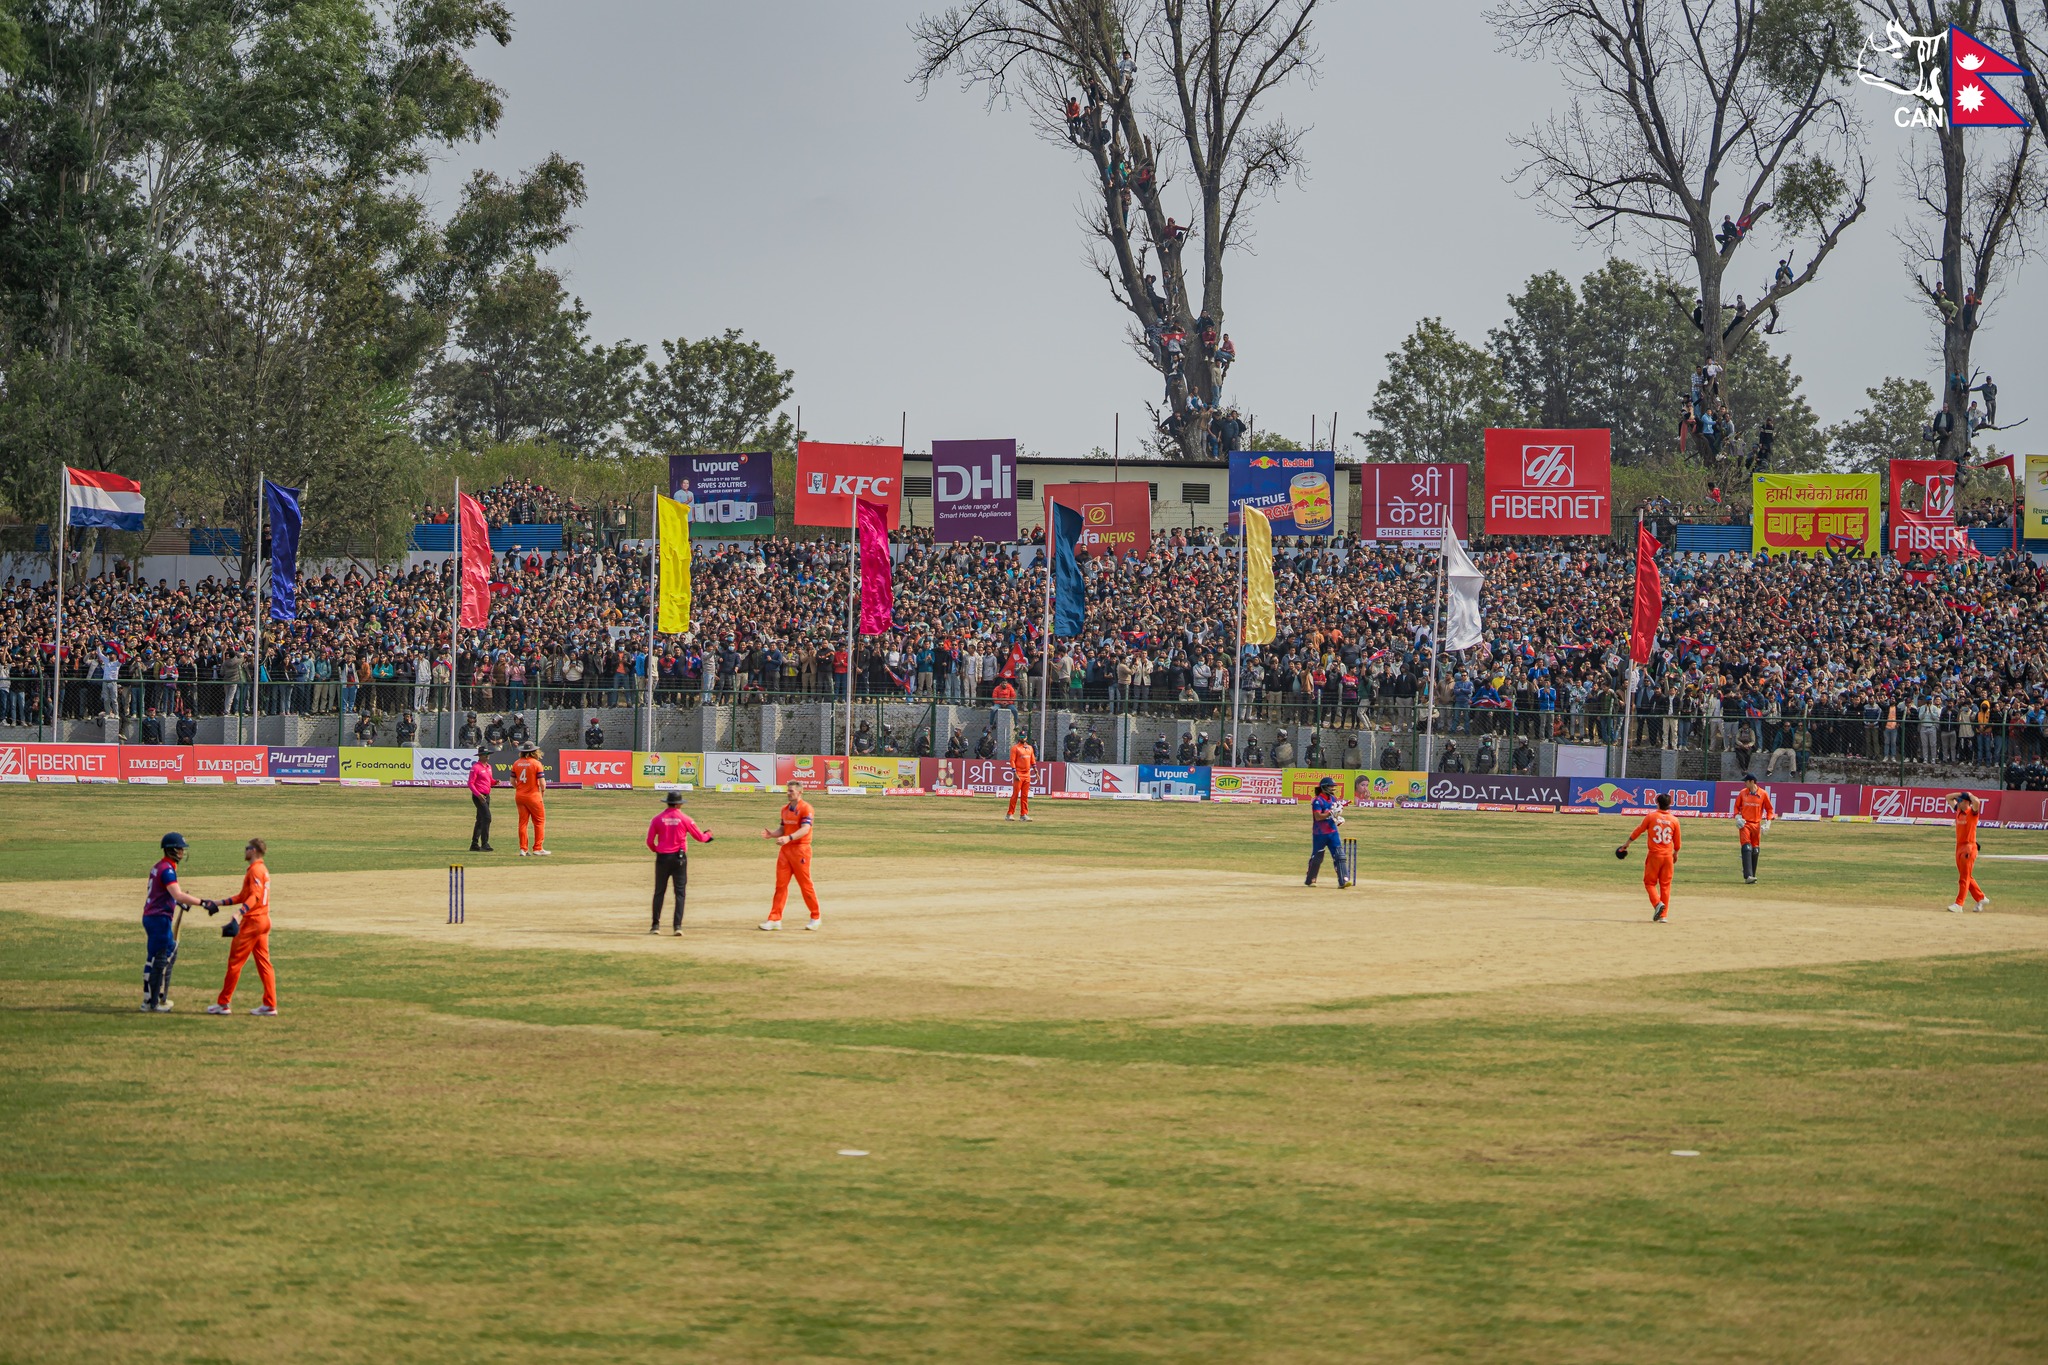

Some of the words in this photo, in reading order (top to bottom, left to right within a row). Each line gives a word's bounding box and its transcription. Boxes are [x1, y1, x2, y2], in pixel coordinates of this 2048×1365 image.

[692, 459, 739, 474] Livpure
[1282, 458, 1297, 467] Red
[1299, 458, 1314, 467] Bull
[831, 475, 891, 496] KFC
[1410, 467, 1442, 496] श्री
[1255, 493, 1285, 506] TRUE
[1491, 495, 1605, 518] FIBERNET
[28, 754, 106, 770] FIBERNET
[270, 753, 332, 763] Plumber
[356, 761, 411, 769] Foodmandu
[520, 769, 527, 783] 4
[584, 762, 624, 775] KFC
[969, 761, 996, 783] श्री
[1154, 768, 1189, 779] Livpure
[1462, 785, 1563, 802] DATALAYA
[1676, 790, 1708, 807] Bull
[1653, 825, 1672, 844] 36
